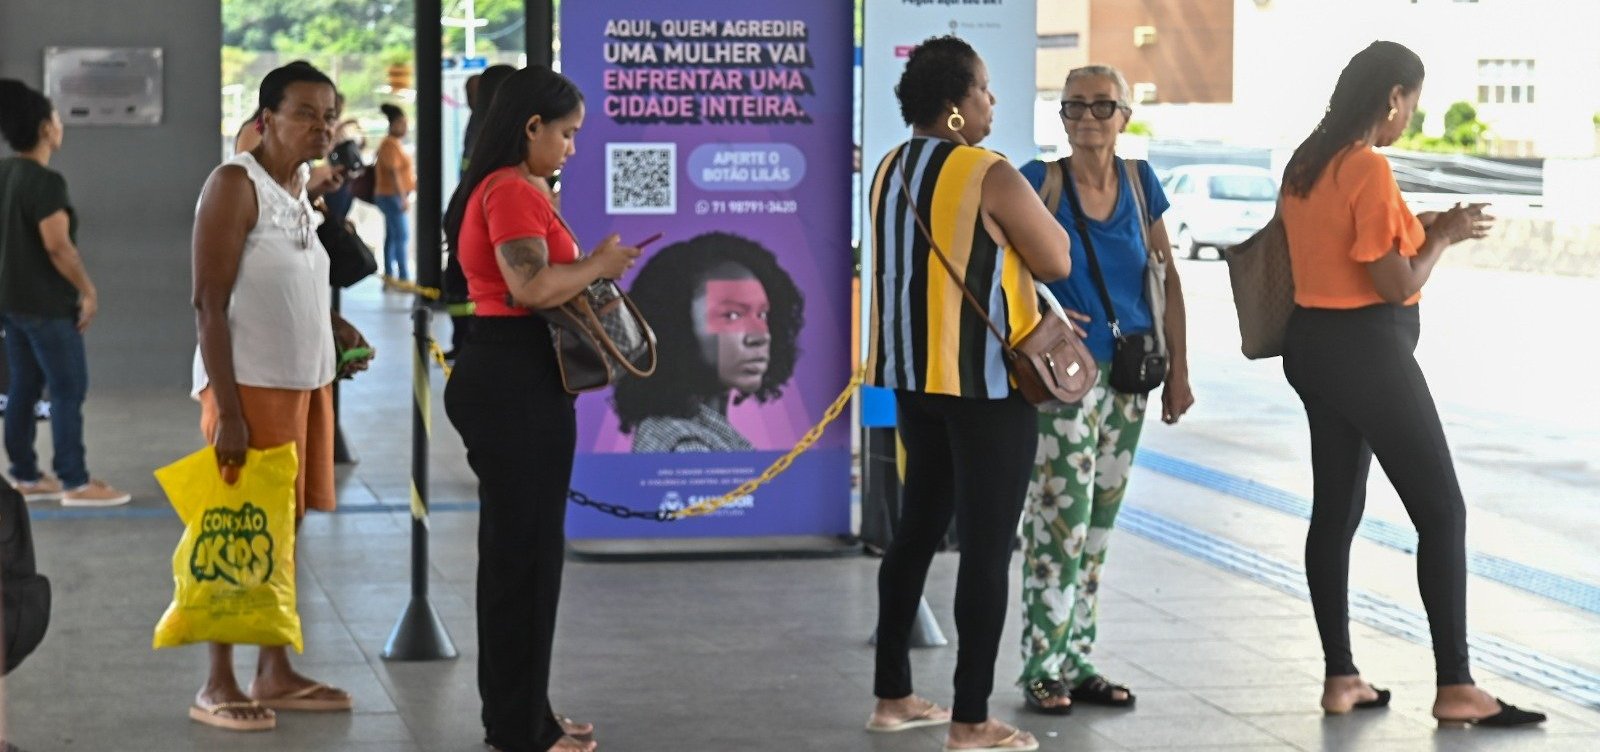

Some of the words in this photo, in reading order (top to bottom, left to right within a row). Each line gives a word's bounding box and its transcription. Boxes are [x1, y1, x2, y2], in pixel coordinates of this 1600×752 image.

[604, 20, 657, 39] AQUI,
[661, 20, 717, 37] QUEM
[721, 20, 805, 37] AGREDIR
[603, 42, 658, 63] UMA
[664, 42, 761, 63] MULHER
[767, 42, 805, 63] VAI
[603, 69, 742, 90] ENFRENTAR
[750, 69, 805, 90] UMA
[603, 95, 694, 117] CIDADE
[701, 95, 804, 117] INTEIRA.
[713, 151, 766, 165] APERTE
[768, 151, 780, 165] O
[702, 165, 749, 181] BOTÃO
[751, 165, 791, 181] LILÁS
[711, 200, 726, 213] 71
[203, 508, 264, 531] CONXÃO
